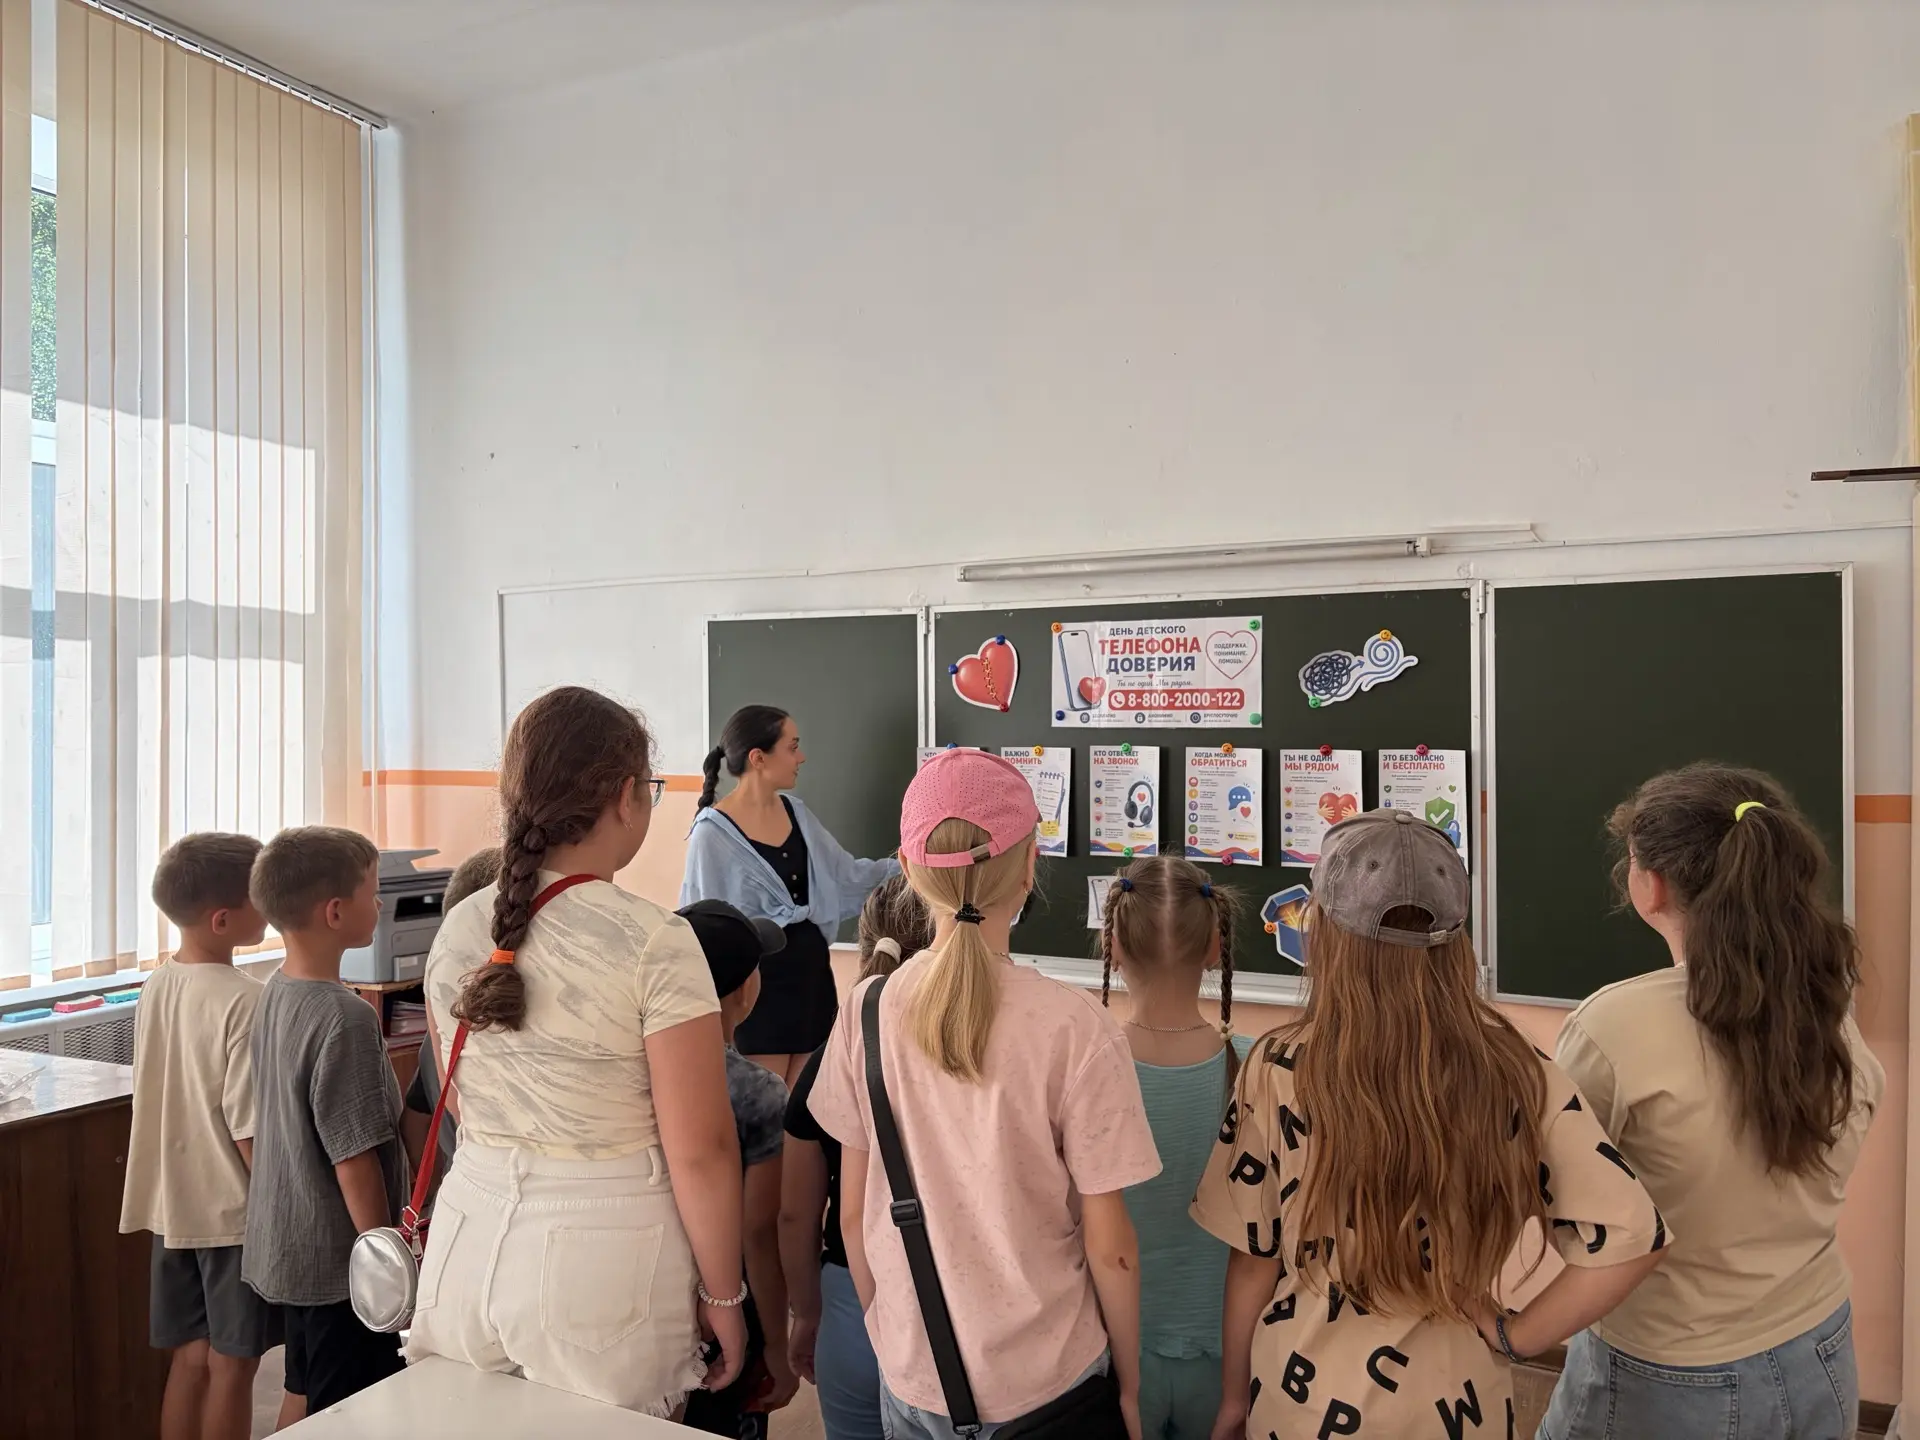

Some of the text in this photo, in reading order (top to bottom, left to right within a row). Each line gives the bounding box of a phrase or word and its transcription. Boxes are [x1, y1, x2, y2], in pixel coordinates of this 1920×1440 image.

[1108, 625, 1186, 637] ДЕНЬ ДЕТСКОГО
[1098, 636, 1202, 656] ТЕЛЕФОНА
[1105, 656, 1196, 675] ДОВЕРИЯ
[1127, 691, 1241, 707] 8-800-2000-122
[1004, 757, 1042, 765] ПОМНИТЬ
[1093, 757, 1139, 765] НА ЗВОНОК
[1191, 758, 1247, 767] ОБРАТИТЬСЯ
[1310, 754, 1333, 762] ОДИН
[1399, 754, 1445, 762] БЕЗОПАСНО
[1284, 762, 1339, 772] МЫ РЯДОМ
[1382, 762, 1446, 771] И БЕСПЛАТНО
[1228, 1150, 1267, 1186] P
[1247, 1217, 1281, 1258] U
[1281, 1350, 1317, 1405] B
[1434, 1379, 1483, 1440] W
[1317, 1398, 1362, 1440] P
